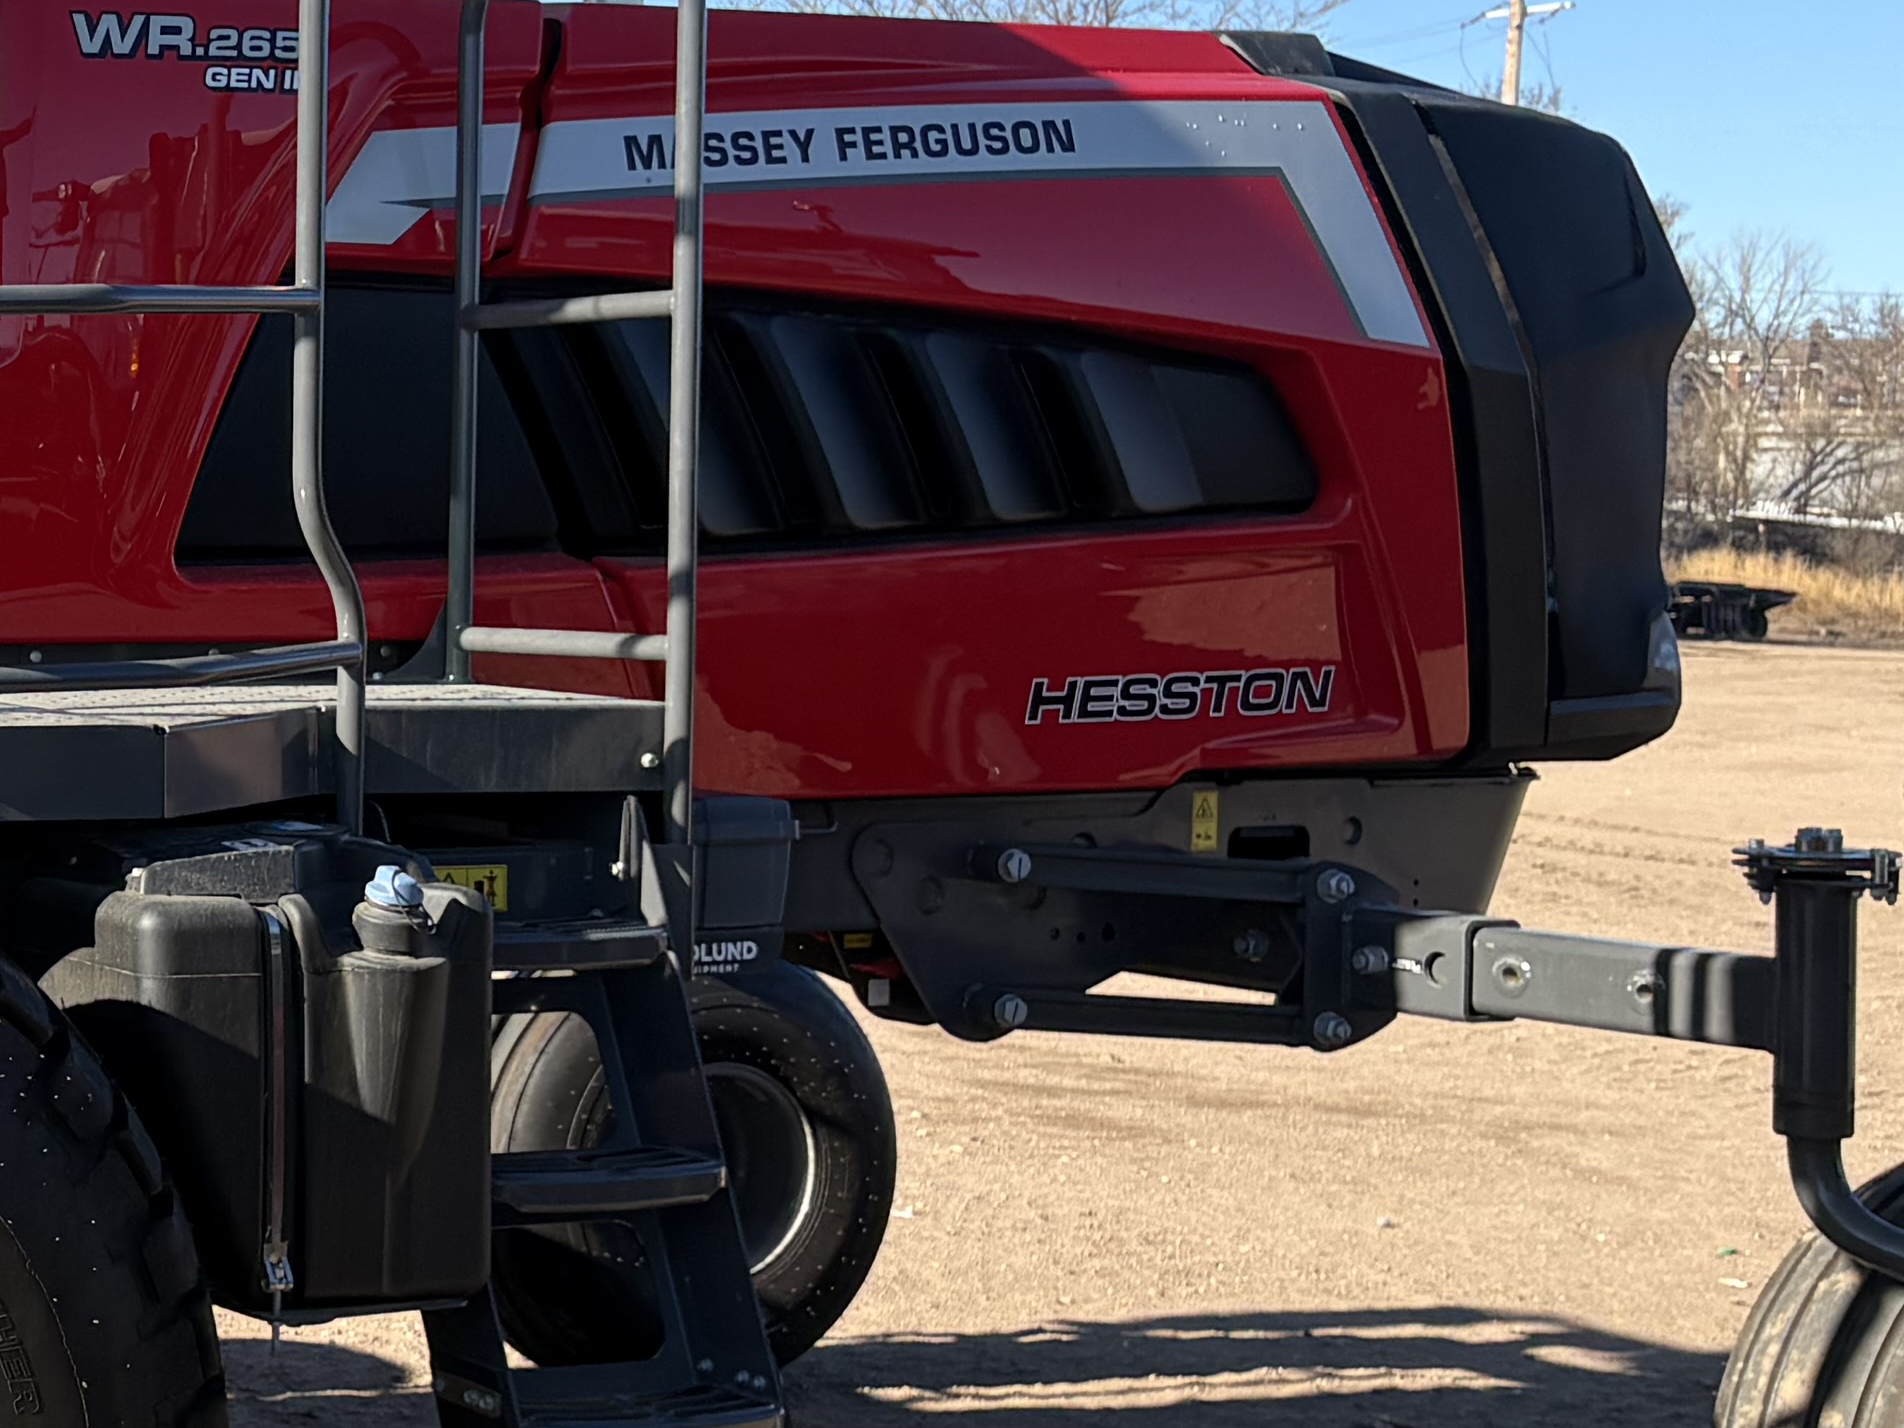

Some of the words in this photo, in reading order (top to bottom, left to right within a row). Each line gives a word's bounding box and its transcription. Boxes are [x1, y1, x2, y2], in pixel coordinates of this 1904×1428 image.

[70, 12, 300, 60] WR.265
[204, 66, 276, 90] GEN
[623, 127, 816, 172] MSSEY
[834, 118, 1076, 162] FERGUSON
[1025, 665, 1336, 725] HESSTON
